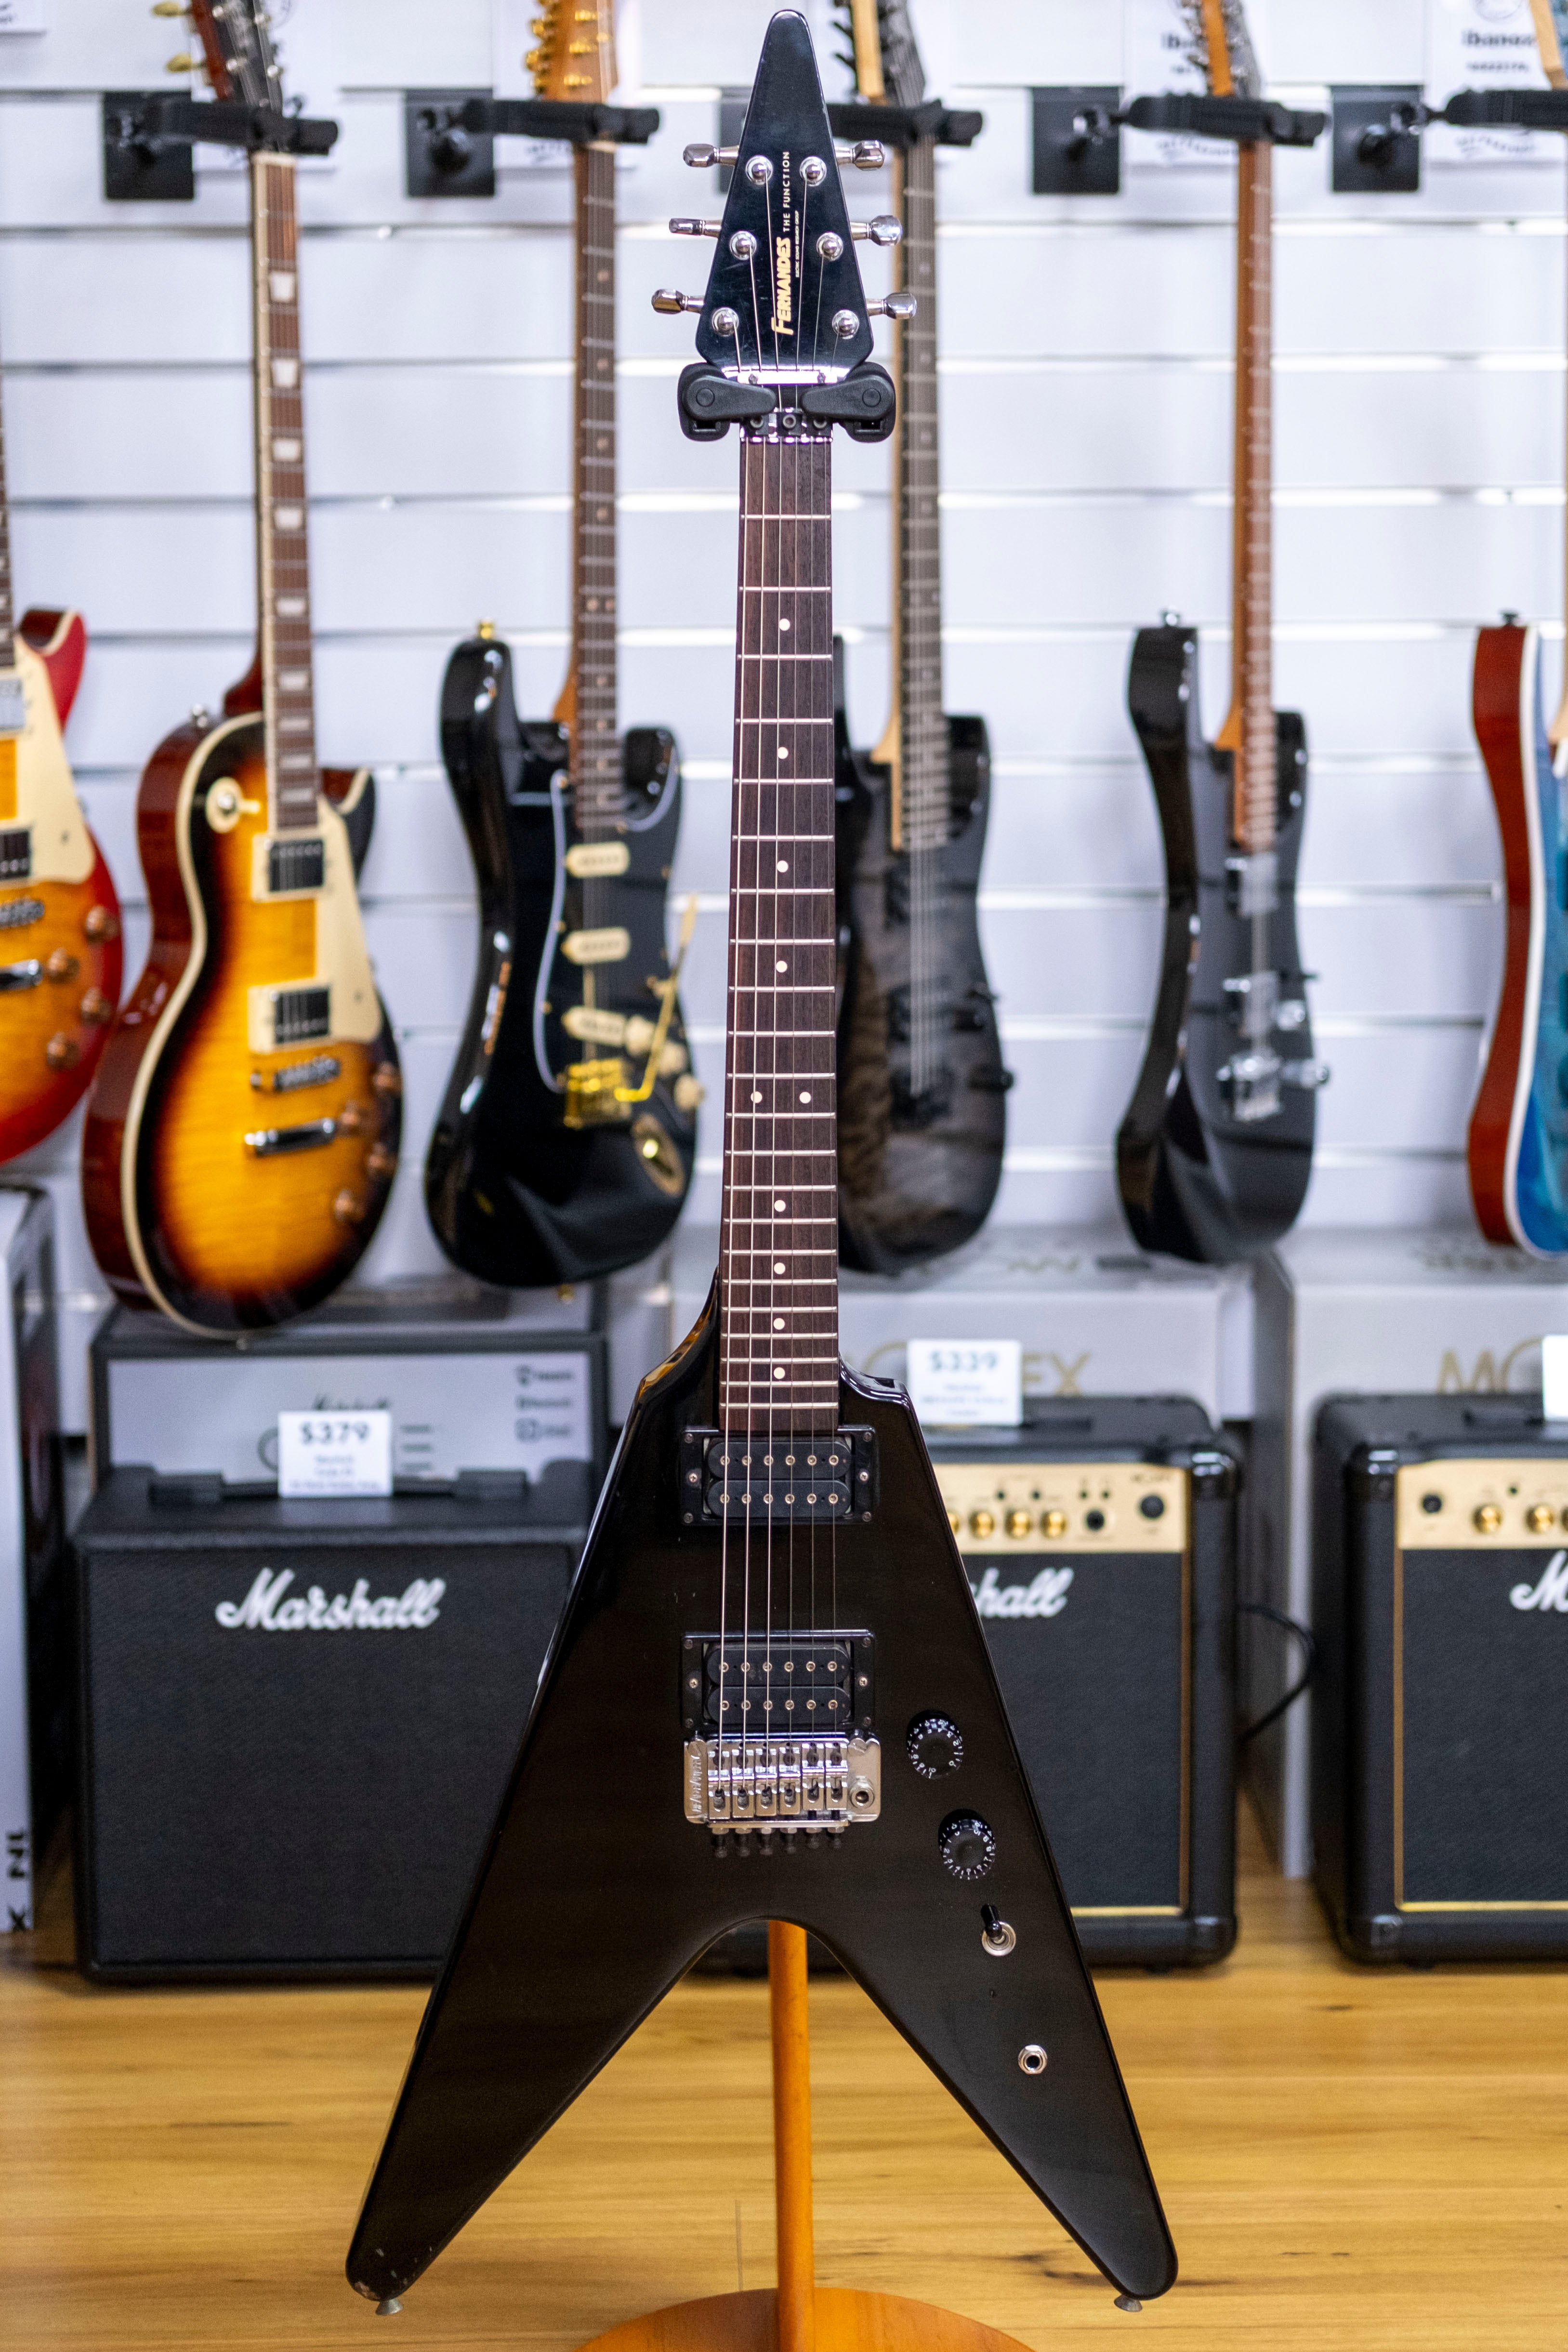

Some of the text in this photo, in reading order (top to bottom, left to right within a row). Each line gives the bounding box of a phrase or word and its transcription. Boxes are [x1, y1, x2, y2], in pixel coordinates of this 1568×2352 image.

[771, 237, 793, 335] FERNANDES
[929, 1350, 999, 1373] $339
[300, 1421, 369, 1445] $379
[215, 1567, 446, 1631] Marshall
